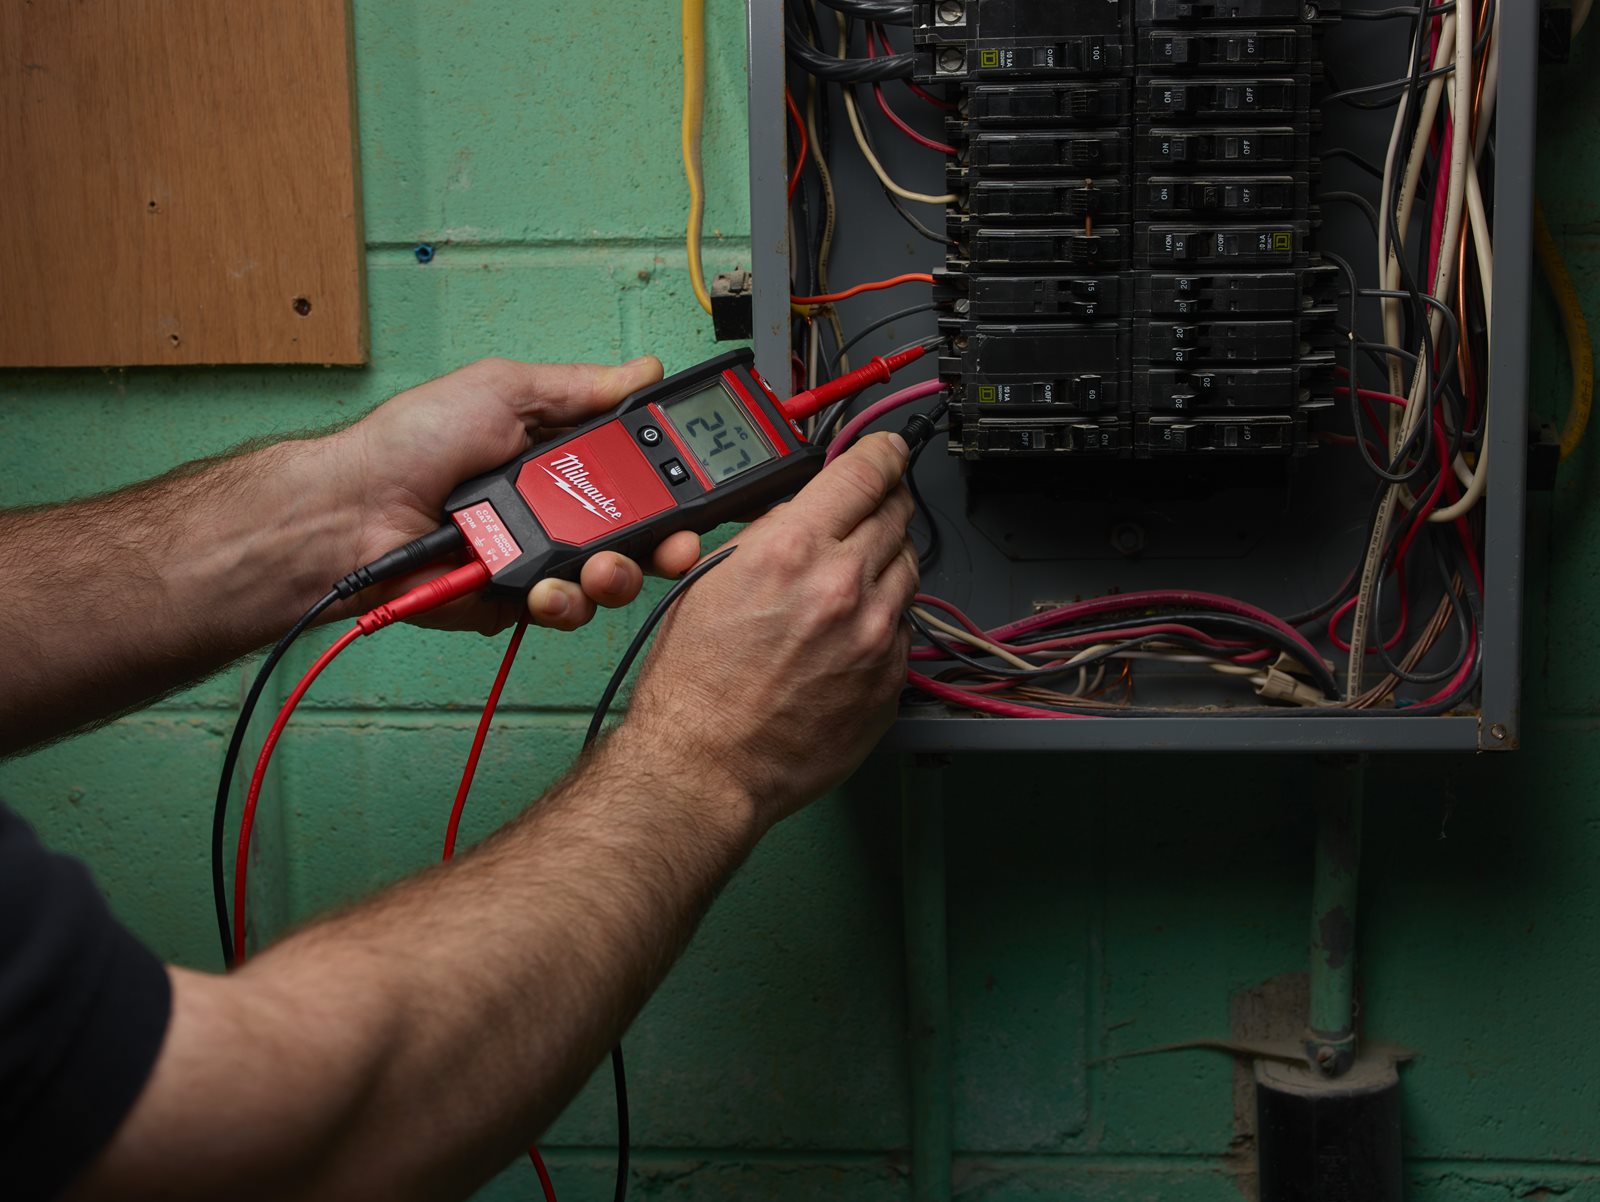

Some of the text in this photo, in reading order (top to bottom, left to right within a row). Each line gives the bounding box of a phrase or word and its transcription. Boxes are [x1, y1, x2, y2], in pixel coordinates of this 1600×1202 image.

[1165, 43, 1172, 55] ON
[1247, 37, 1255, 53] OFF
[1092, 46, 1100, 60] 100
[1006, 59, 1013, 68] kA
[1164, 91, 1172, 104] ON
[1246, 87, 1254, 103] OFF
[1161, 142, 1169, 154] ON
[1243, 140, 1251, 155] OFF
[1160, 188, 1168, 200] ON
[1176, 241, 1184, 251] 15
[1087, 281, 1095, 292] 15
[1180, 279, 1188, 289] 20
[1086, 304, 1094, 315] 15
[1179, 302, 1187, 313] 20
[1176, 328, 1184, 339] 20
[1175, 351, 1183, 362] 20
[1203, 377, 1211, 387] 20
[1004, 394, 1011, 402] kA
[1088, 389, 1096, 400] 60
[1175, 398, 1183, 408] 20
[734, 426, 748, 441] AC
[1164, 428, 1172, 440] ON
[1244, 425, 1252, 440] OFF
[686, 411, 751, 475] 247
[1021, 431, 1029, 447] OFF
[1101, 433, 1109, 446] ON
[550, 452, 622, 520] Milwaukee
[463, 512, 477, 528] COM
[1375, 515, 1383, 535] NYLON
[476, 510, 488, 523] CAT
[493, 535, 511, 557] 1000V
[482, 509, 494, 523] CAT
[499, 533, 514, 552] 600V
